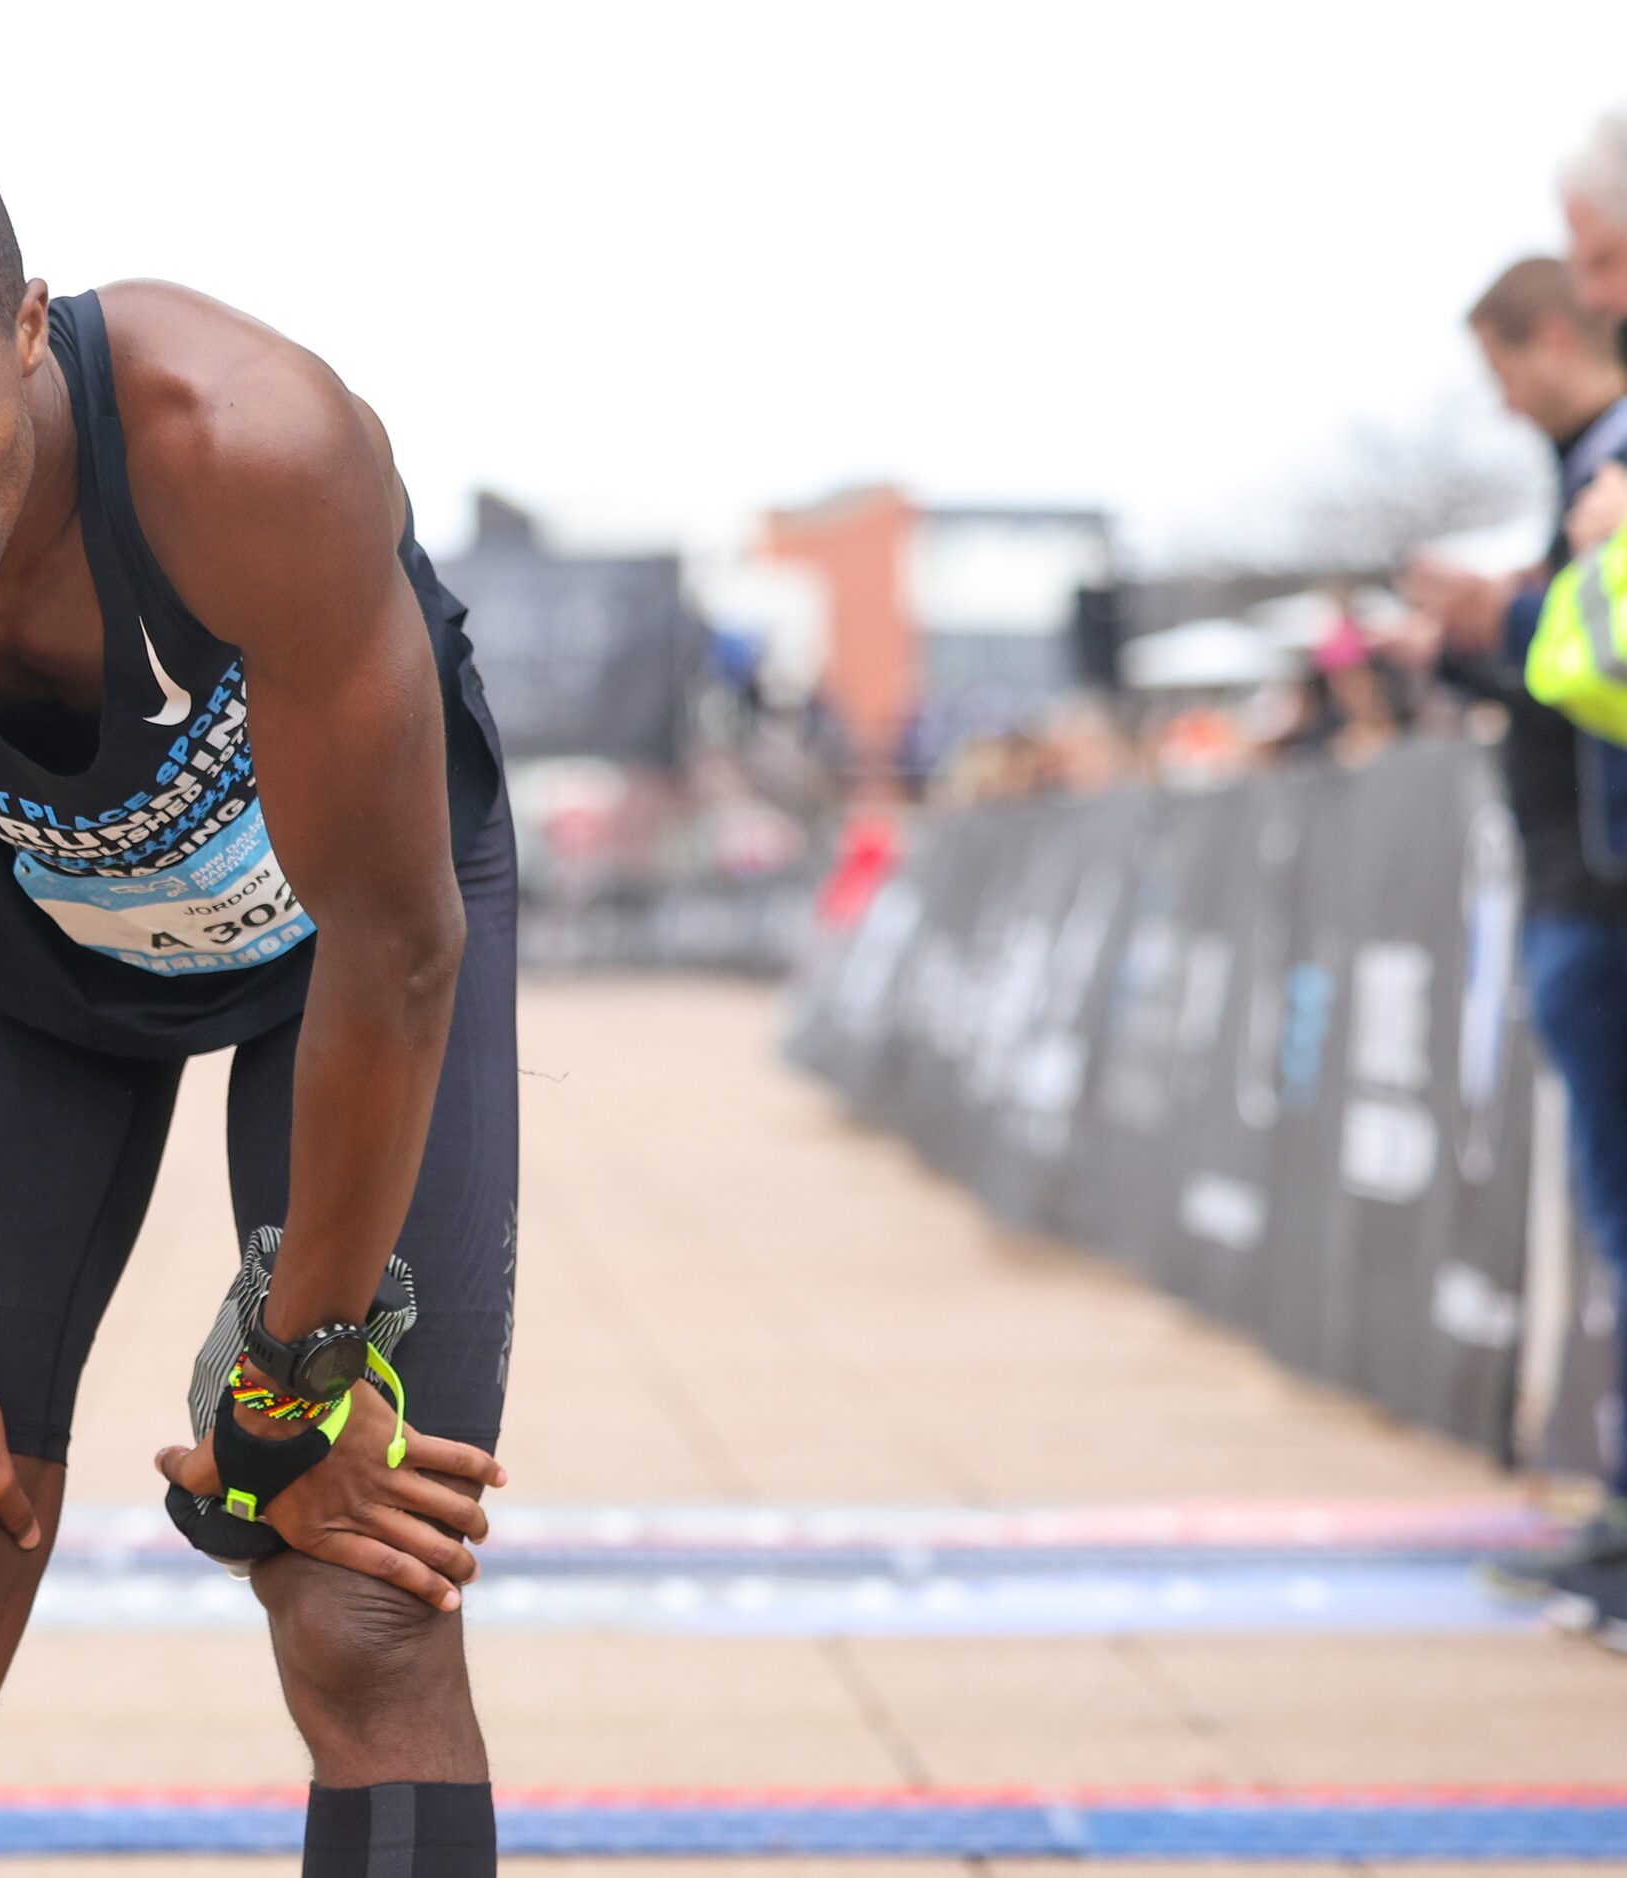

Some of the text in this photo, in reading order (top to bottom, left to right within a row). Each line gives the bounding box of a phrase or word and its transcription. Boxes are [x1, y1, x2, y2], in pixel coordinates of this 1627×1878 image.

[18, 791, 153, 832] PLACE
[156, 655, 243, 786] SPORT
[206, 721, 248, 778] 197
[190, 812, 265, 882] BMW DALLA
[184, 869, 271, 916] JORDON
[151, 931, 195, 950] A
